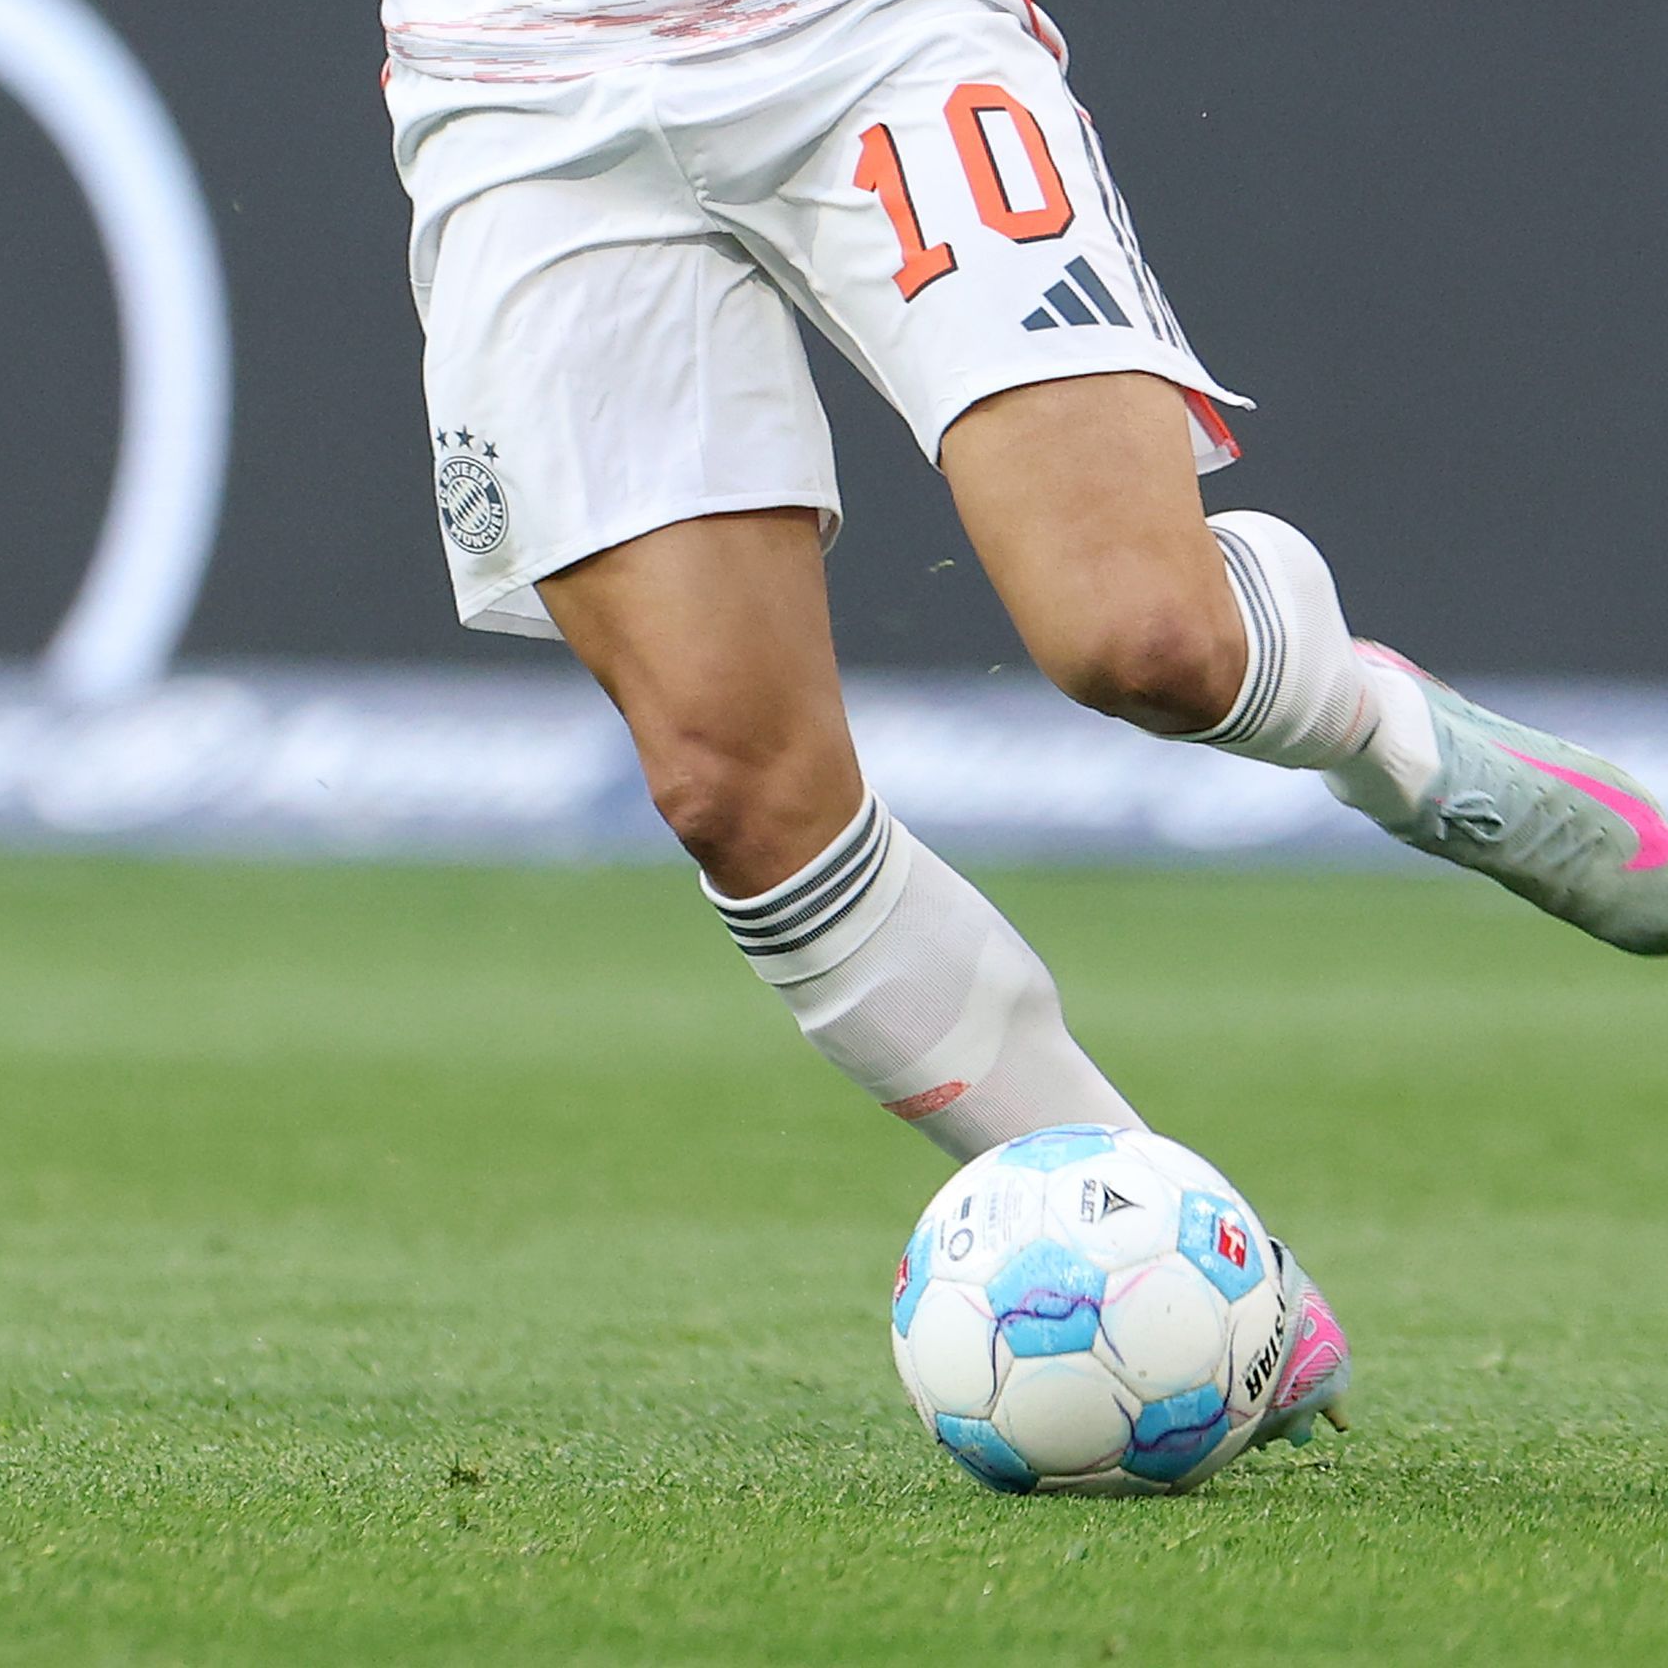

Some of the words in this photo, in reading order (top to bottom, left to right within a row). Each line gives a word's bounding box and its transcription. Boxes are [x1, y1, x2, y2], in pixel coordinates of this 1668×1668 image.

[853, 83, 1076, 303] 10
[440, 463, 493, 490] BAYERN
[1079, 1178, 1097, 1224] SELECT
